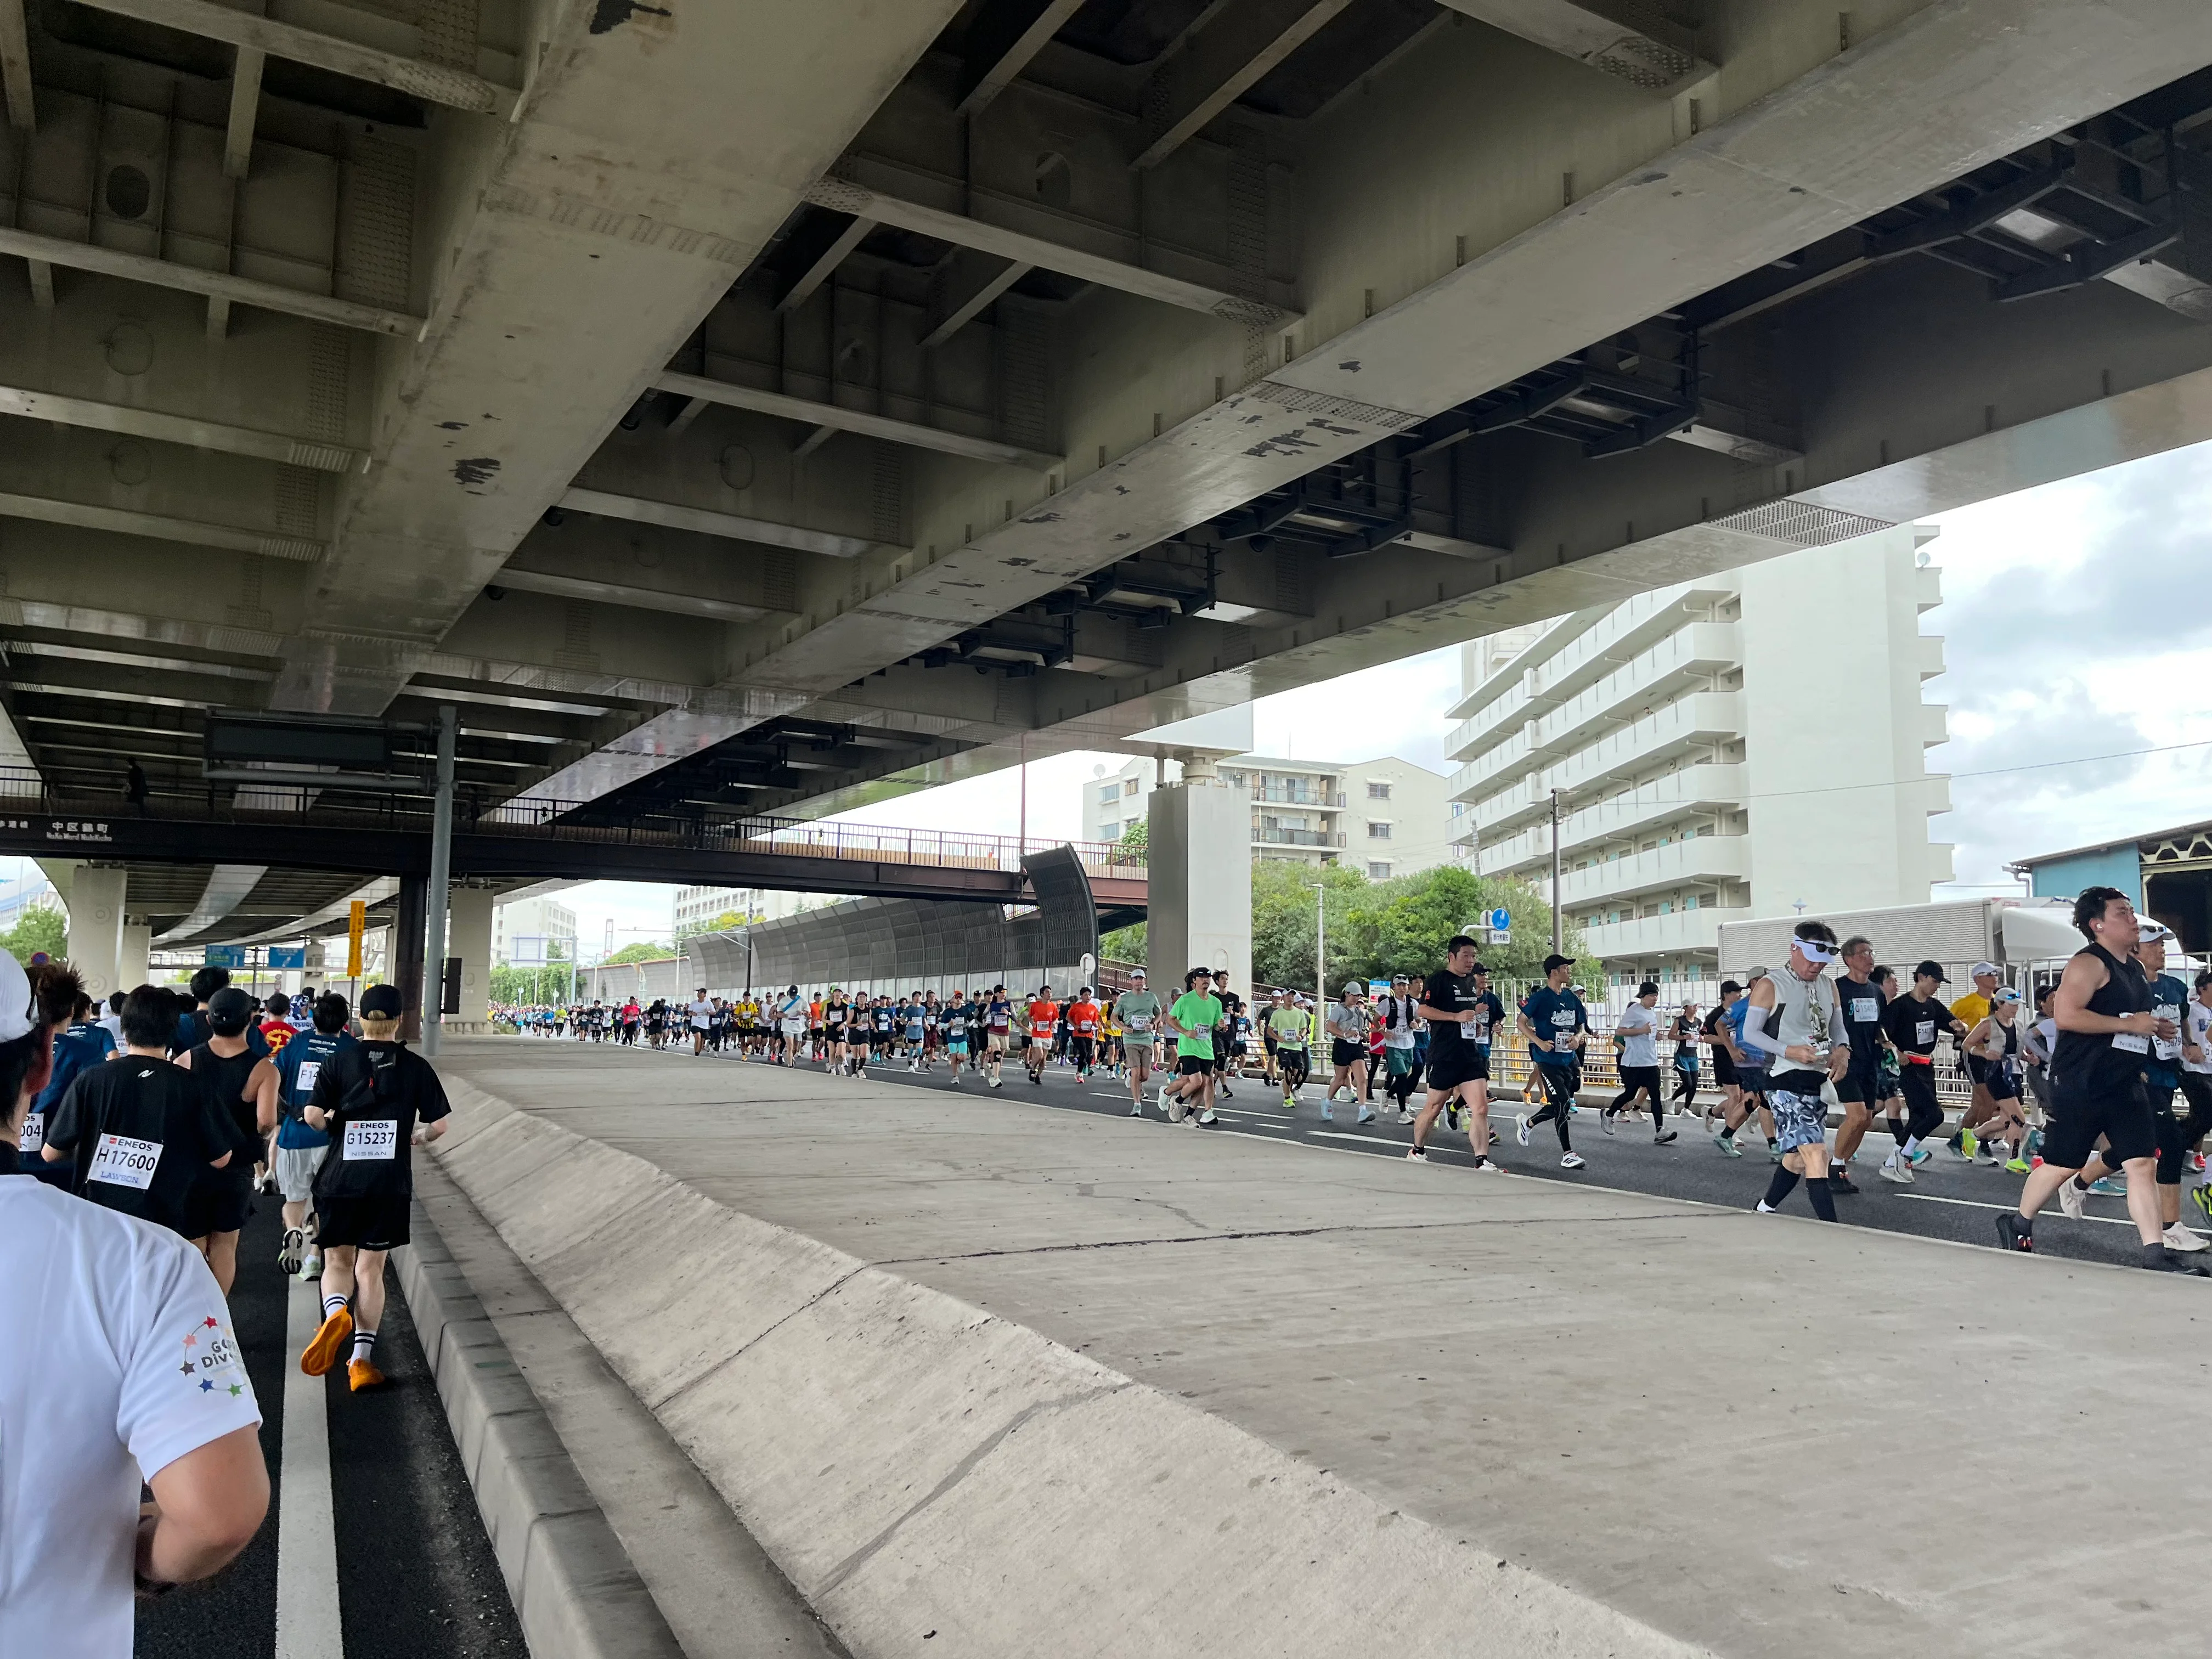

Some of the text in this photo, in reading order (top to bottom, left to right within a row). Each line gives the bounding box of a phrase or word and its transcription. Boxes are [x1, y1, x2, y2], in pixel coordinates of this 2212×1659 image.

[117, 1138, 153, 1151] ENEOS
[347, 1132, 395, 1144] G15237
[96, 1147, 156, 1171] H17600
[100, 1171, 139, 1184] LAWSON
